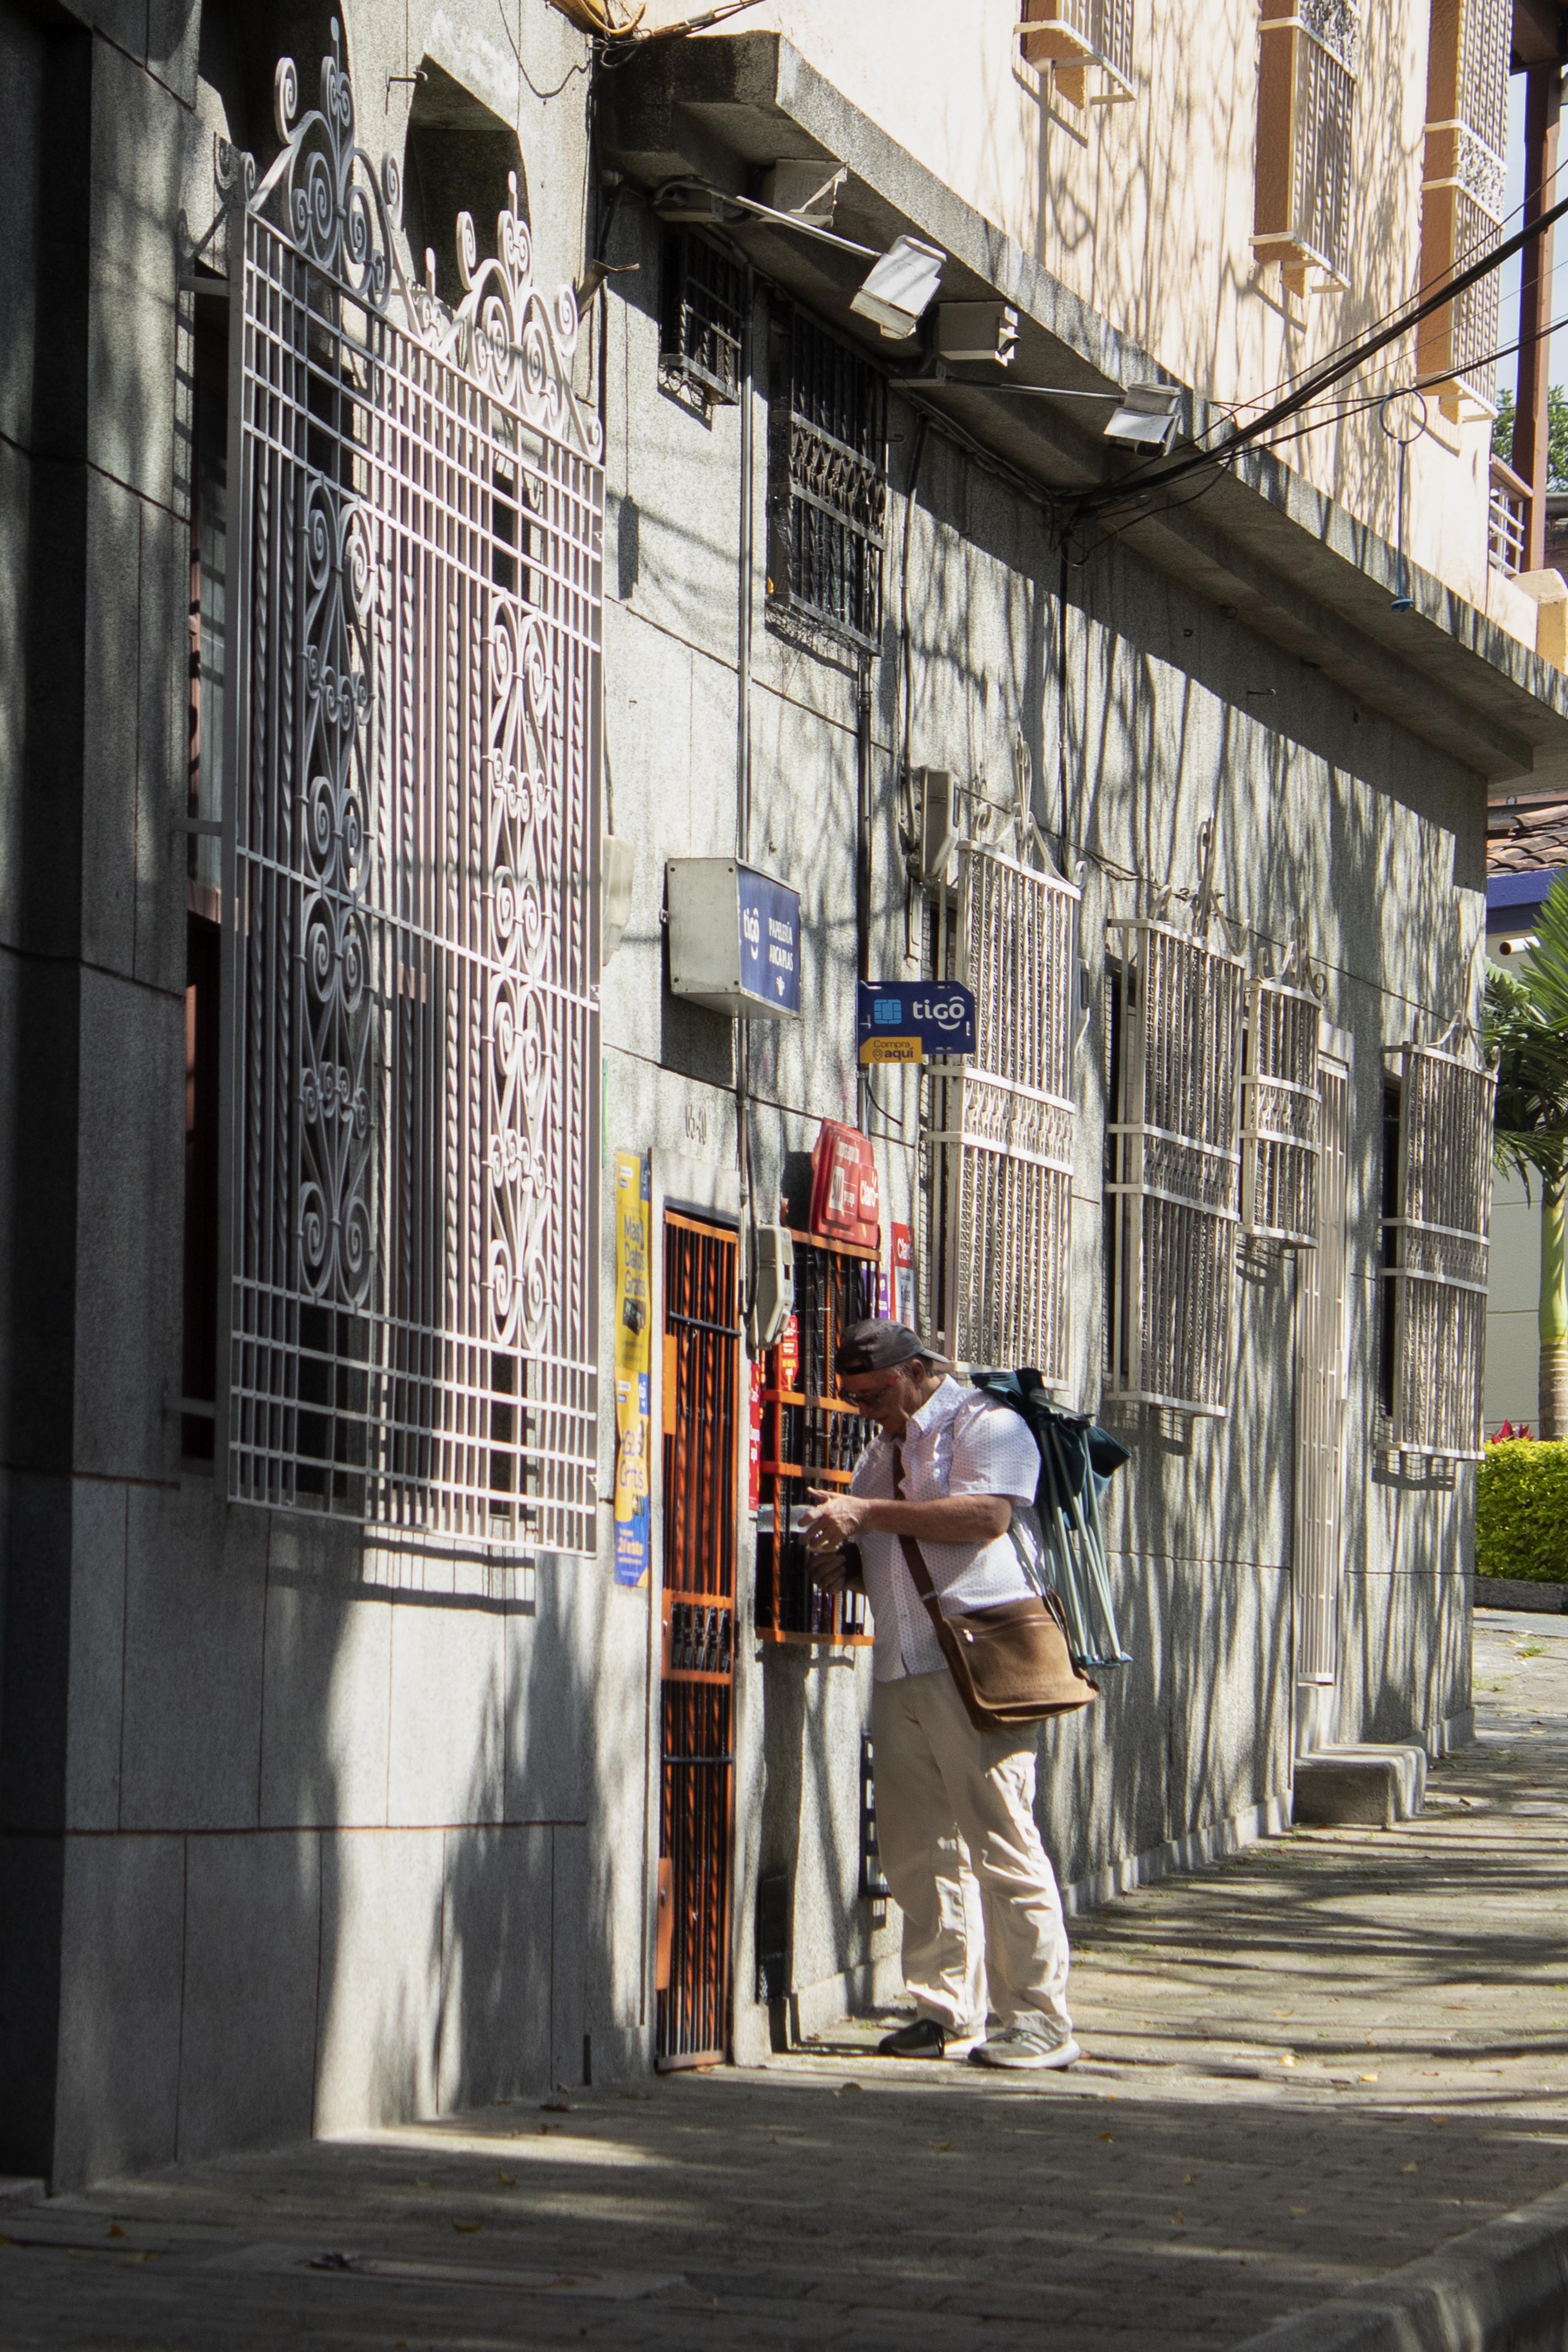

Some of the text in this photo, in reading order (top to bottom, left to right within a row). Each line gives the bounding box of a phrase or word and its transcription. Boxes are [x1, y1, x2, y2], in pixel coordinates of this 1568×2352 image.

[873, 1039, 911, 1049] Compra
[885, 1047, 914, 1061] aquí
[861, 1180, 877, 1208] Claro
